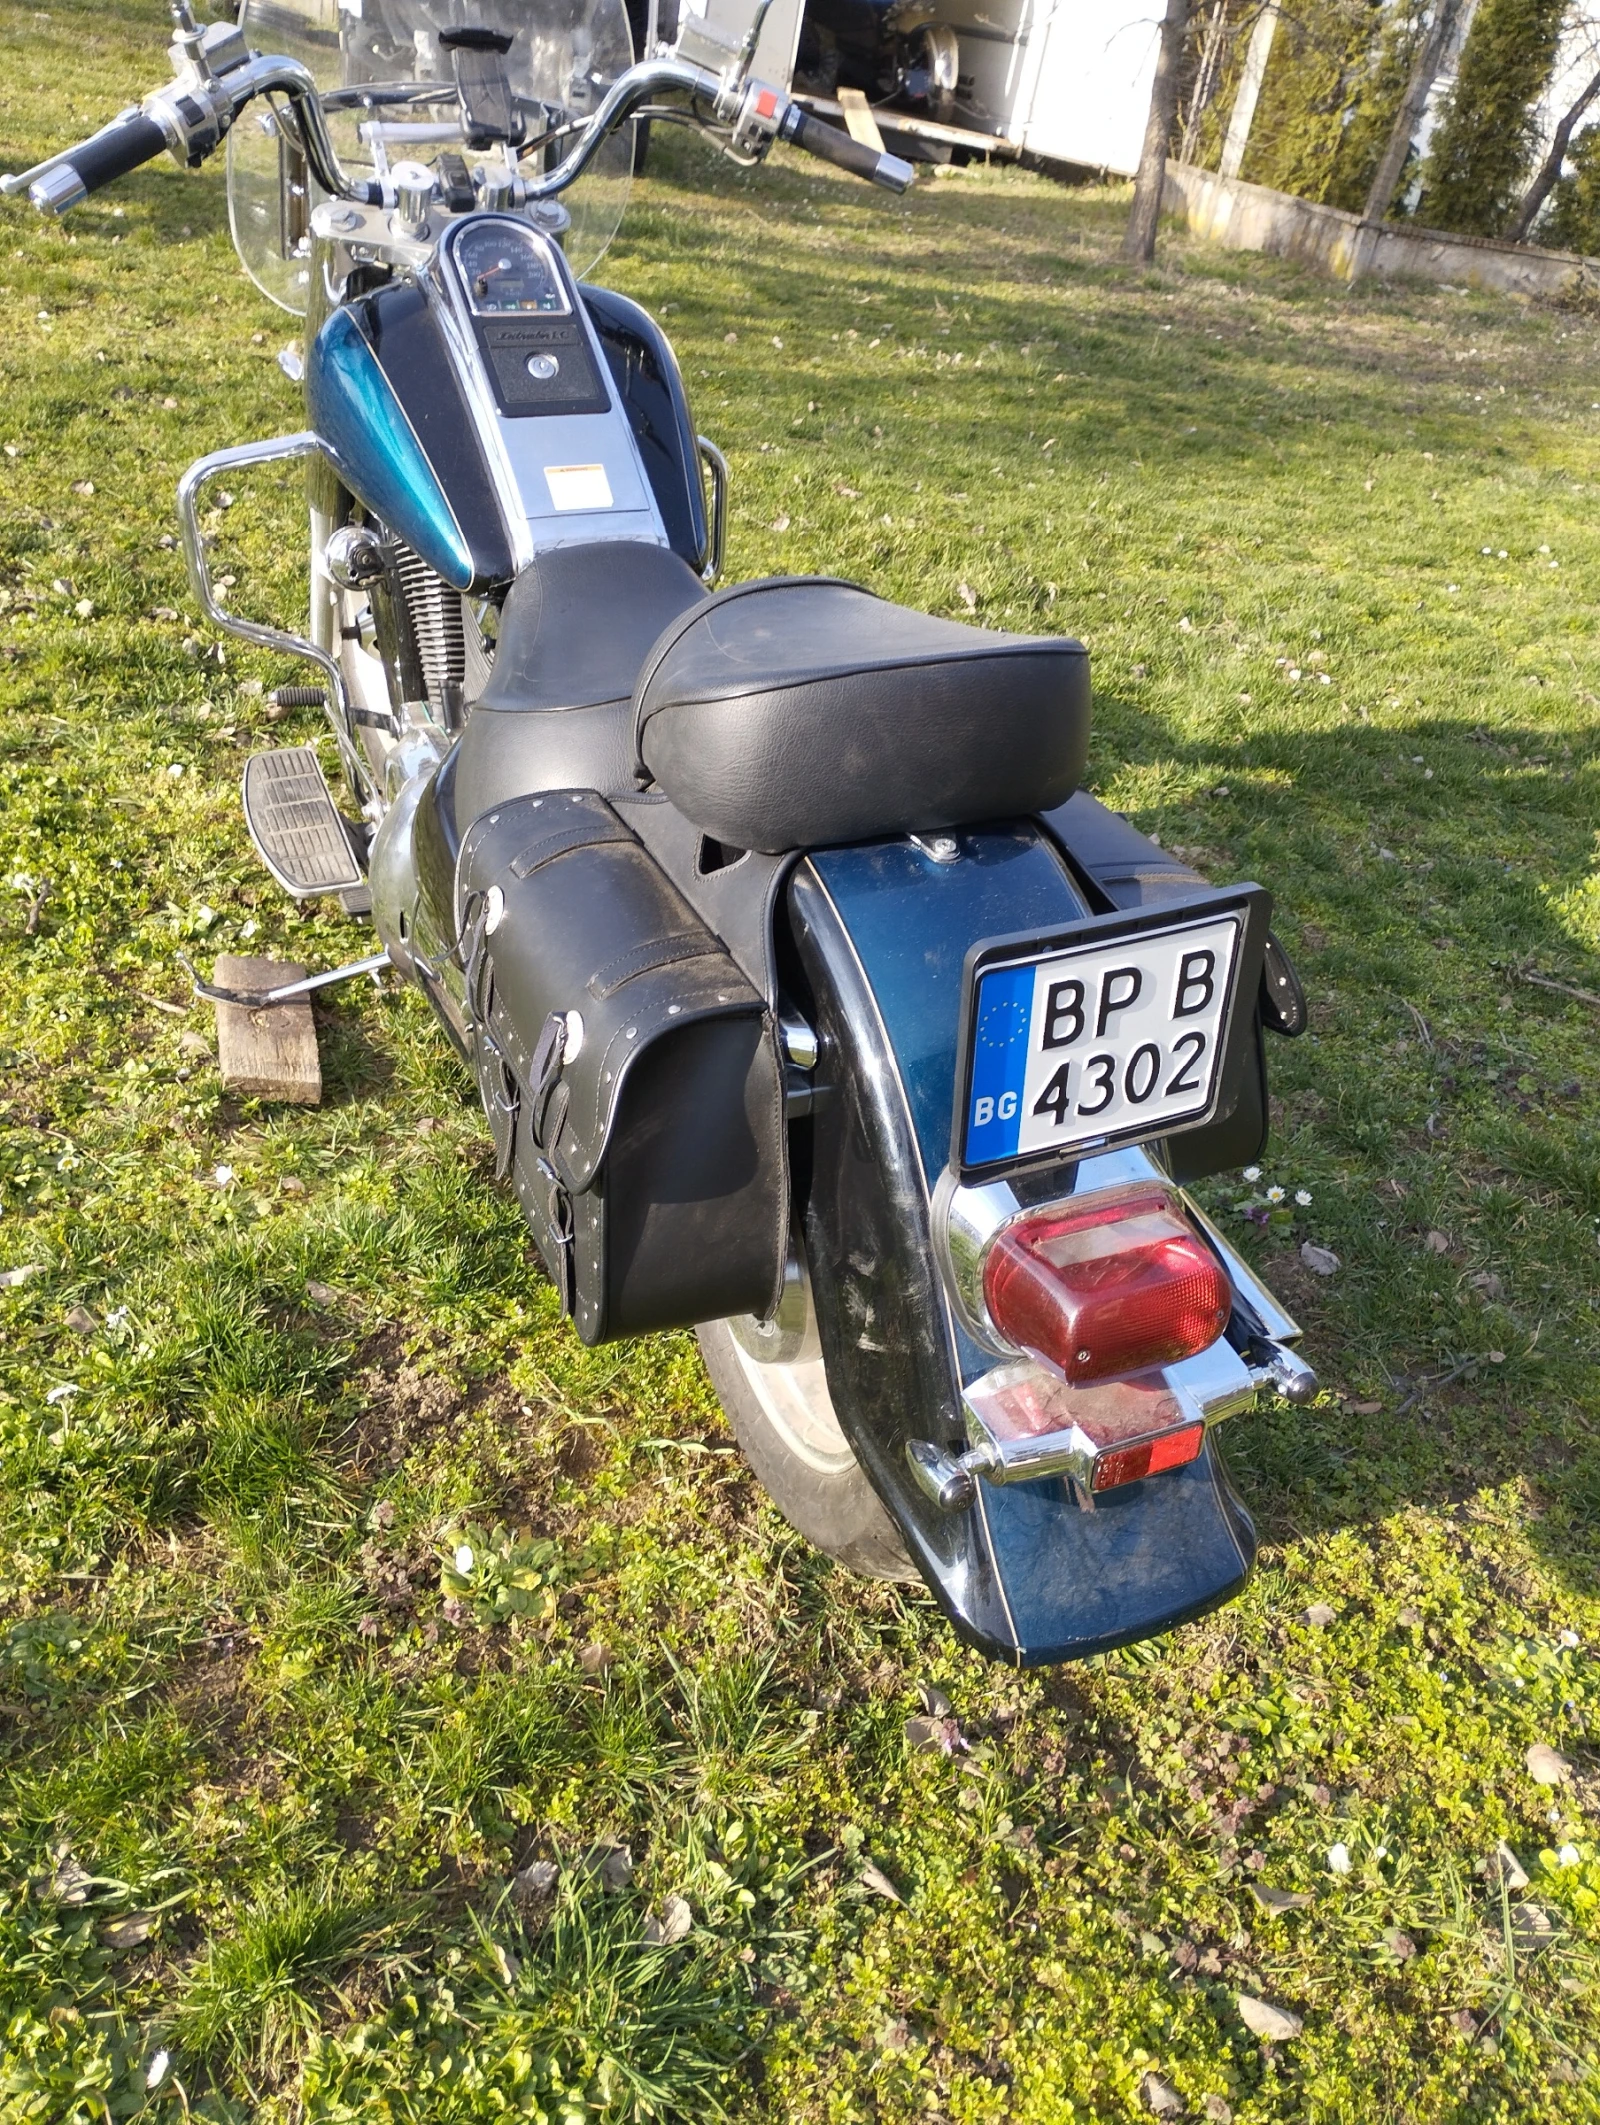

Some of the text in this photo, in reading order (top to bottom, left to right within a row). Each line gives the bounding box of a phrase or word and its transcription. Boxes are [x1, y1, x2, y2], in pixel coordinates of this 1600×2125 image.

[1042, 949, 1216, 1051] BP B
[974, 1091, 1017, 1127] BG
[1031, 1031, 1206, 1126] 4302
